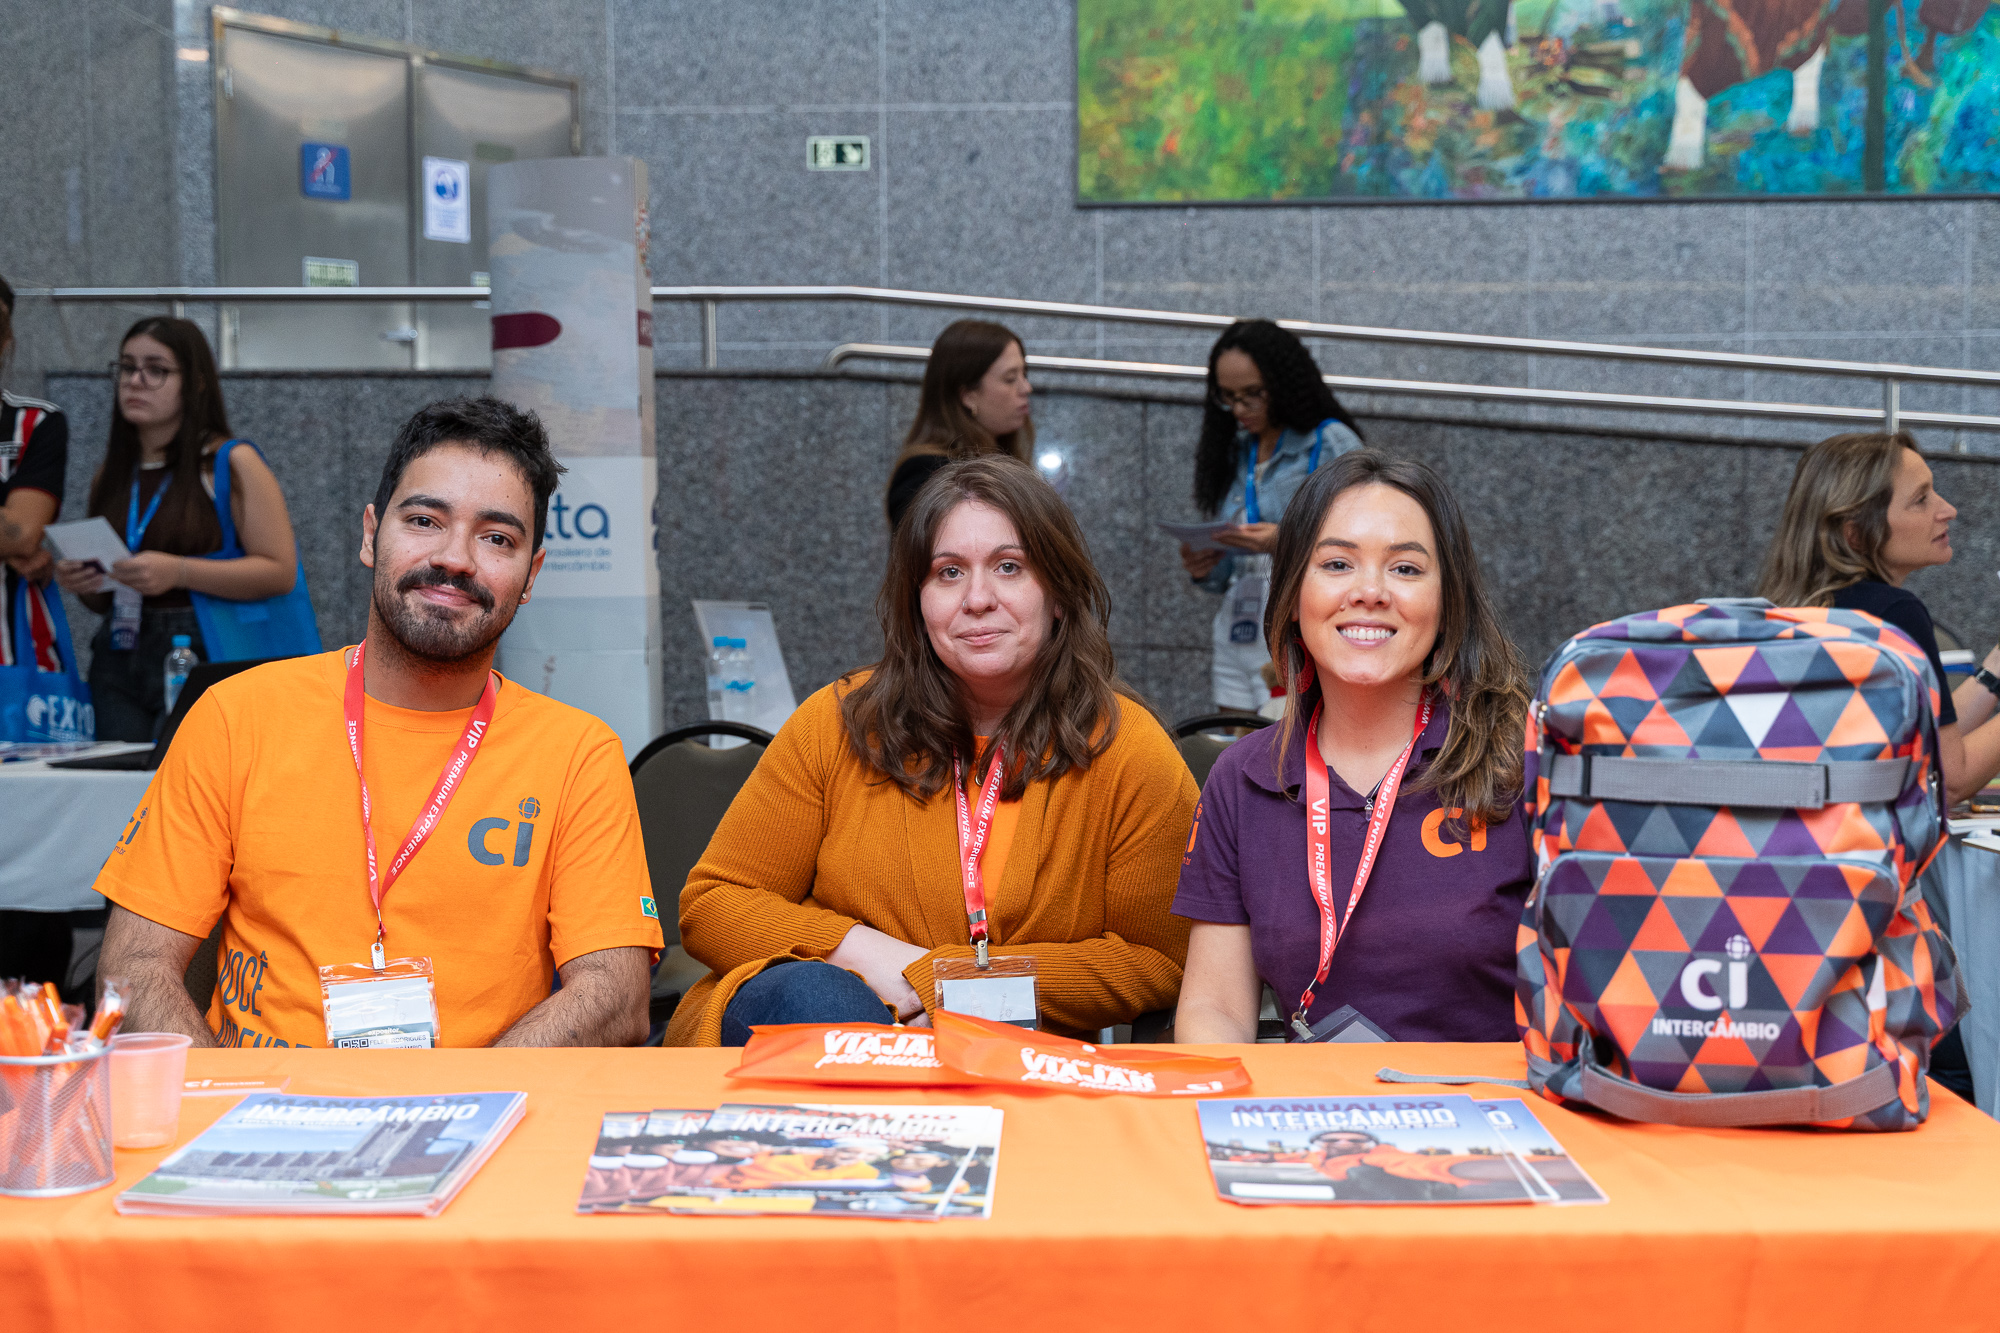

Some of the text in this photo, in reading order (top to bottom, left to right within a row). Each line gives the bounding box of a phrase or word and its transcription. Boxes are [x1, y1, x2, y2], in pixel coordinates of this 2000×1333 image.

[390, 719, 487, 877] VIP PREMIUM EXPERIENCE
[1312, 798, 1327, 836] VIP
[1356, 821, 1381, 887] PREMIUM
[1375, 743, 1412, 820] EXPERIENCE
[367, 847, 378, 882] VIP
[967, 820, 988, 889] EXPERIENCE
[1315, 842, 1330, 908] PREMIUM
[219, 948, 269, 1018] VOCÊ
[1680, 934, 1751, 1012] ci
[367, 1027, 400, 1037] expositor
[1652, 1016, 1781, 1041] INTERCÂMBIO
[1020, 1052, 1157, 1091] VIAJAR
[243, 1103, 481, 1123] INTERCÂMBIO
[1230, 1108, 1457, 1128] INTERCÂMBIO
[1233, 1100, 1446, 1113] MANUAL DO
